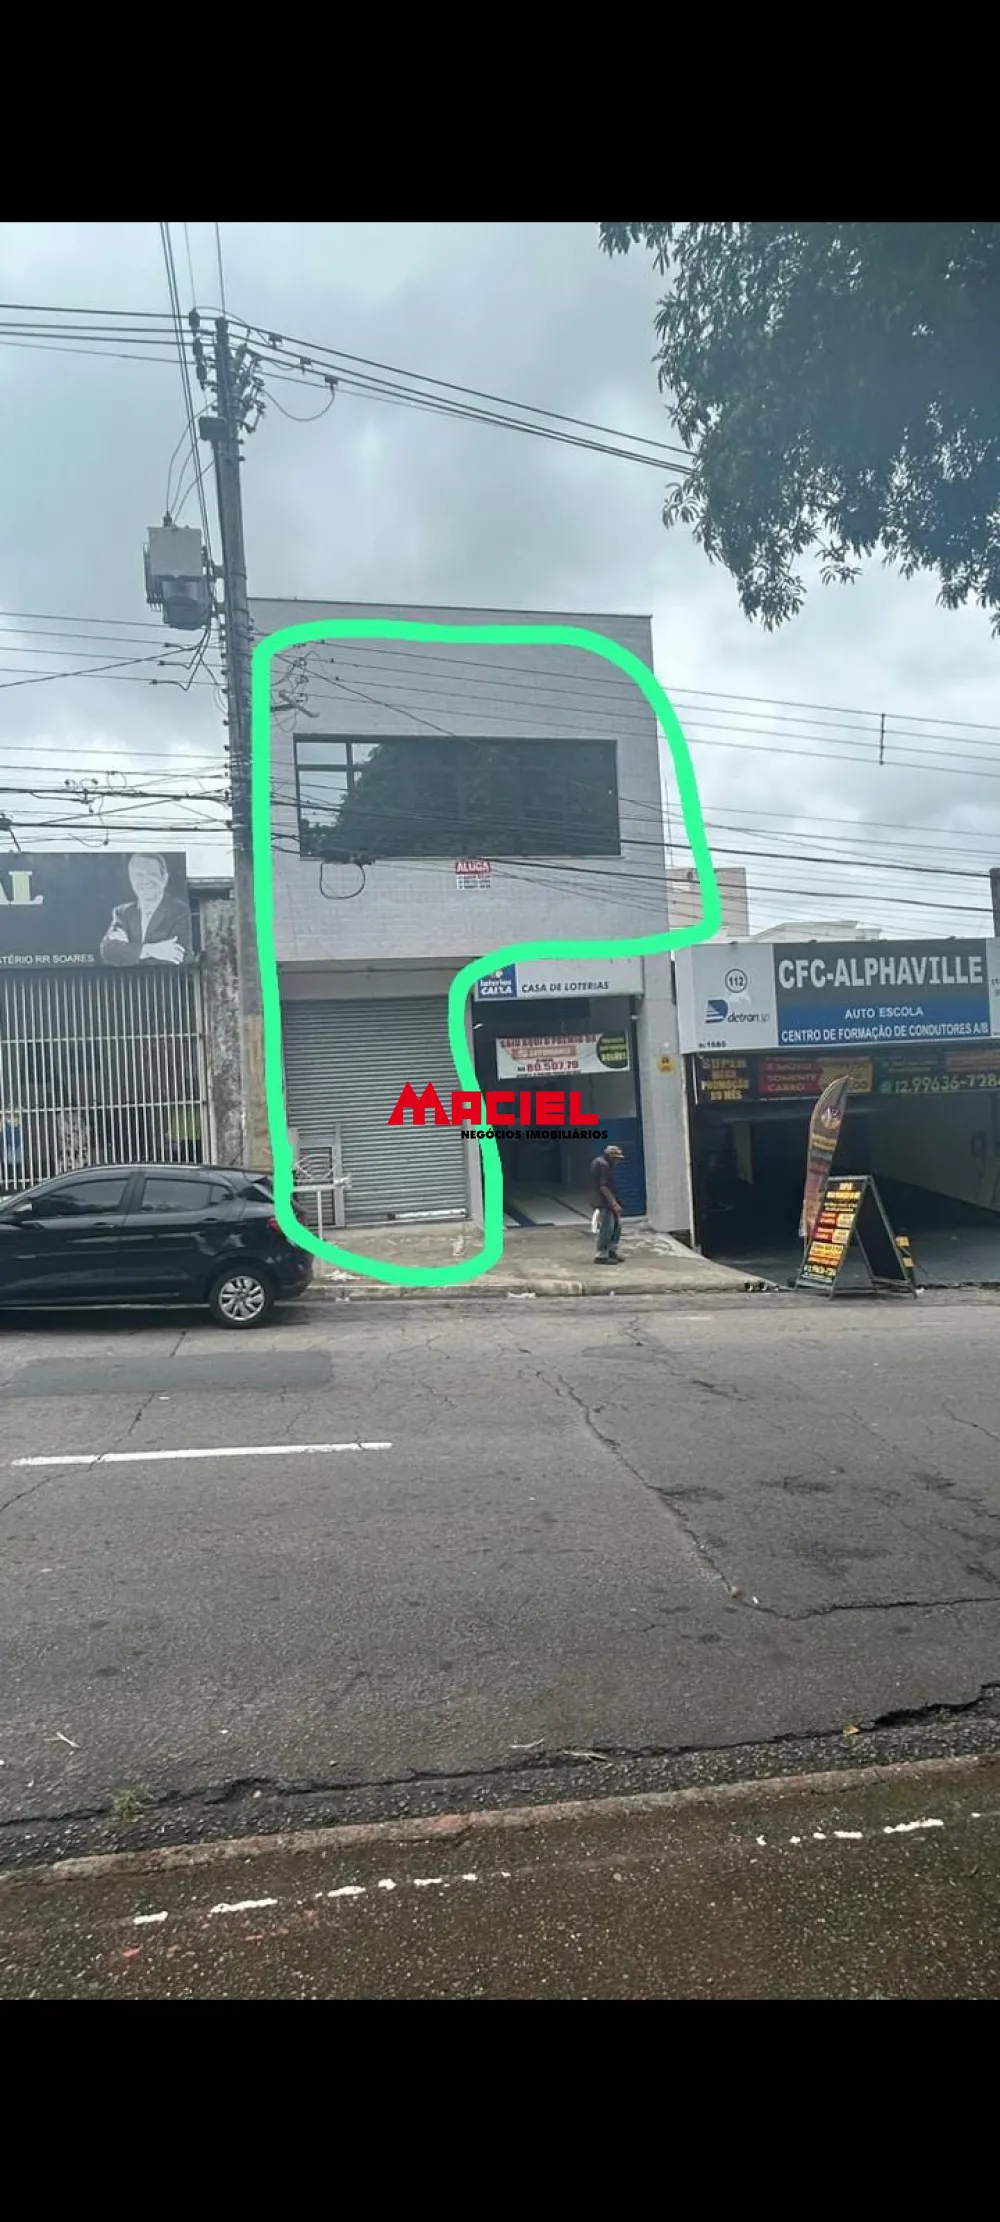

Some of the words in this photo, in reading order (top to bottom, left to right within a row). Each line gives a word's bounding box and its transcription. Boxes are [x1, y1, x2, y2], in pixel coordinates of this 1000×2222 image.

[456, 861, 490, 872] ALUGA
[35, 954, 50, 964] RR
[52, 953, 94, 963] SOARES
[778, 955, 983, 989] CFC-ALPHAVILLE
[521, 983, 547, 993] CASA
[550, 982, 562, 991] DE
[564, 981, 609, 991] LOTERIAS
[729, 976, 744, 987] 112
[481, 986, 512, 995] CAIXA
[844, 1008, 876, 1020] AUTO
[879, 1006, 924, 1018] ESCOLA
[781, 1028, 821, 1043] CENTRO
[823, 1028, 837, 1041] DE
[838, 1025, 893, 1040] FORMAÇÃO
[894, 1025, 908, 1037] DE
[909, 1022, 972, 1036] CONDUTORES
